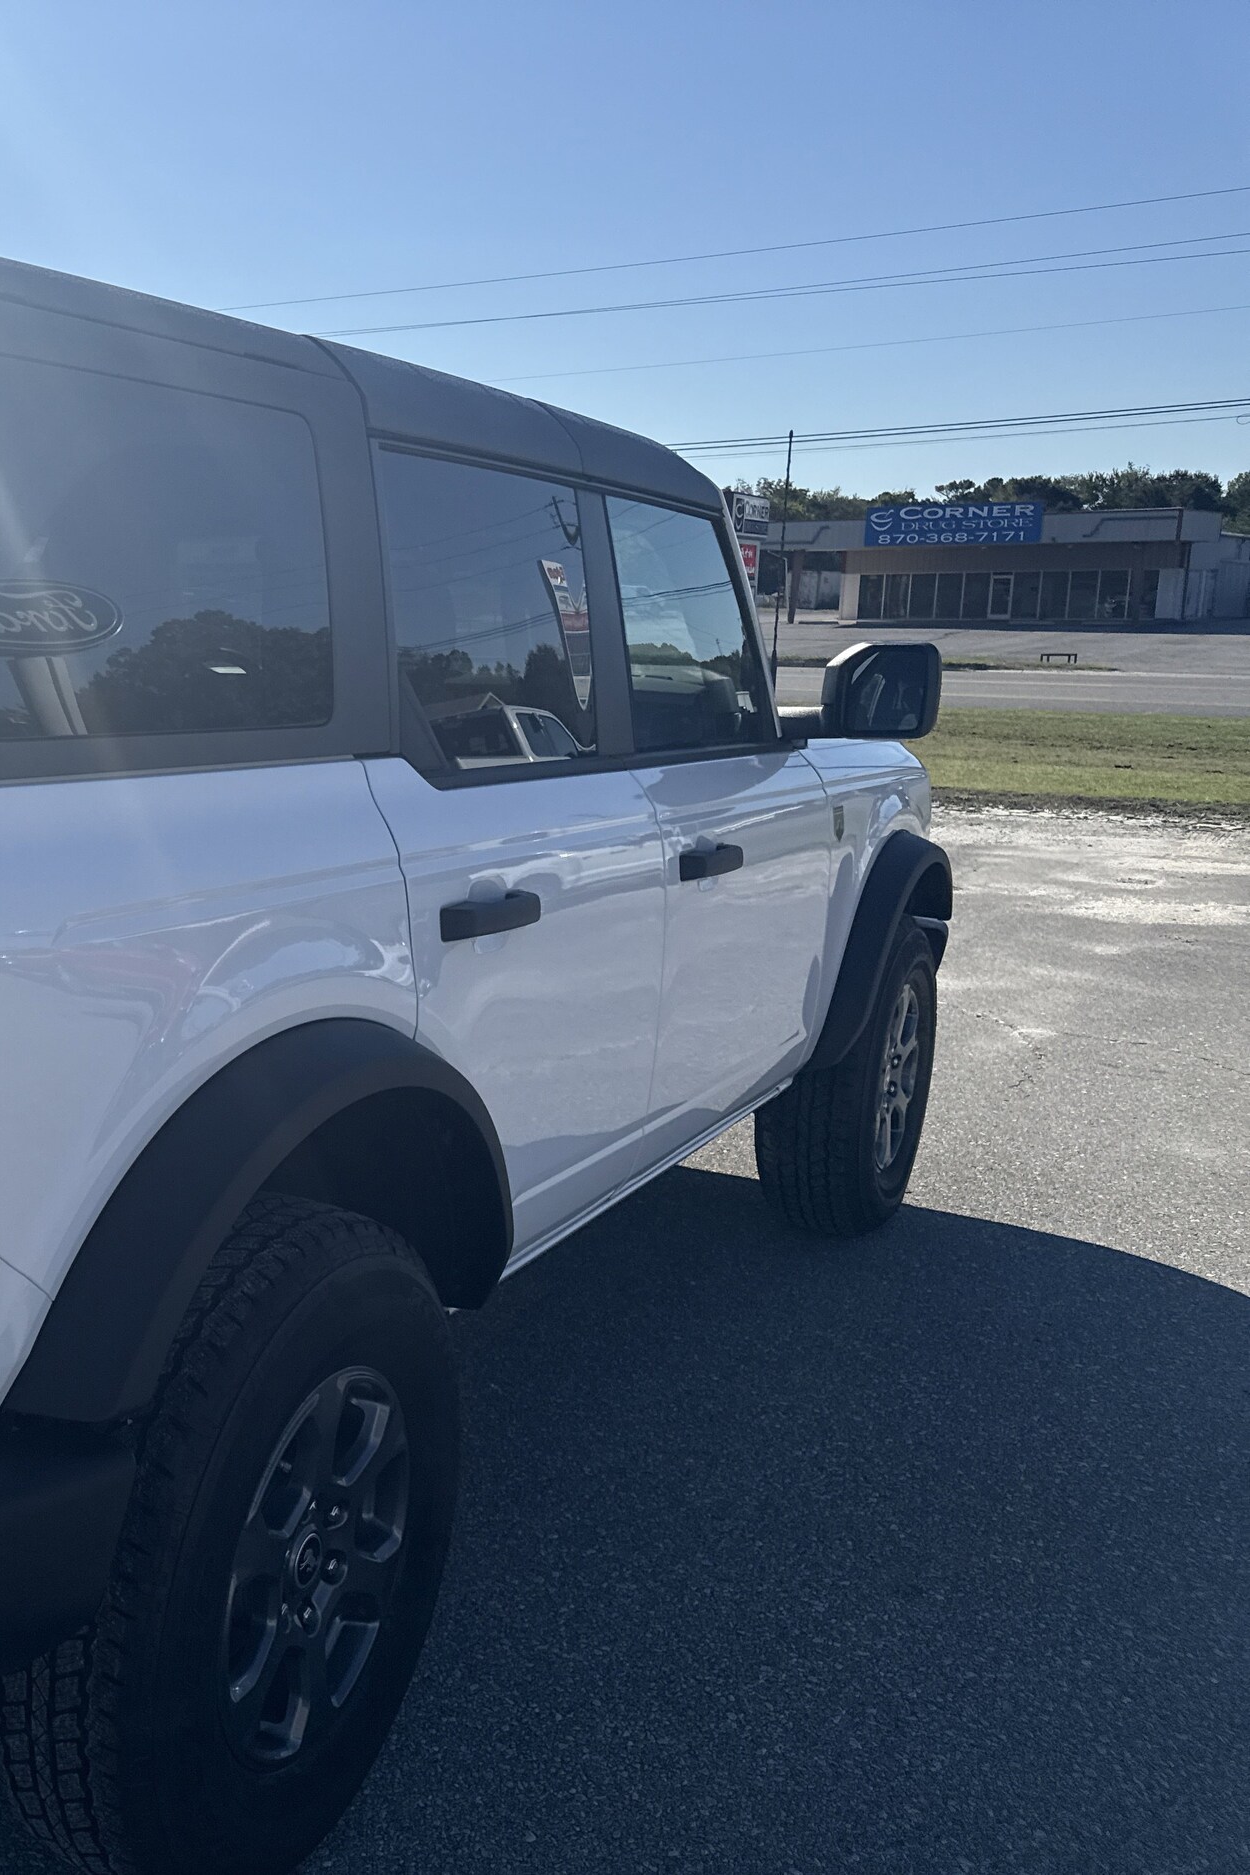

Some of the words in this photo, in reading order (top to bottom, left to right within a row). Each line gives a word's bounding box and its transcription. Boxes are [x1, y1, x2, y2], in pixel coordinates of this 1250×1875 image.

[900, 504, 1035, 520] CORNER
[901, 521, 956, 531] DRUG
[962, 518, 1033, 530] STORE
[878, 531, 1025, 545] 870-368-7171
